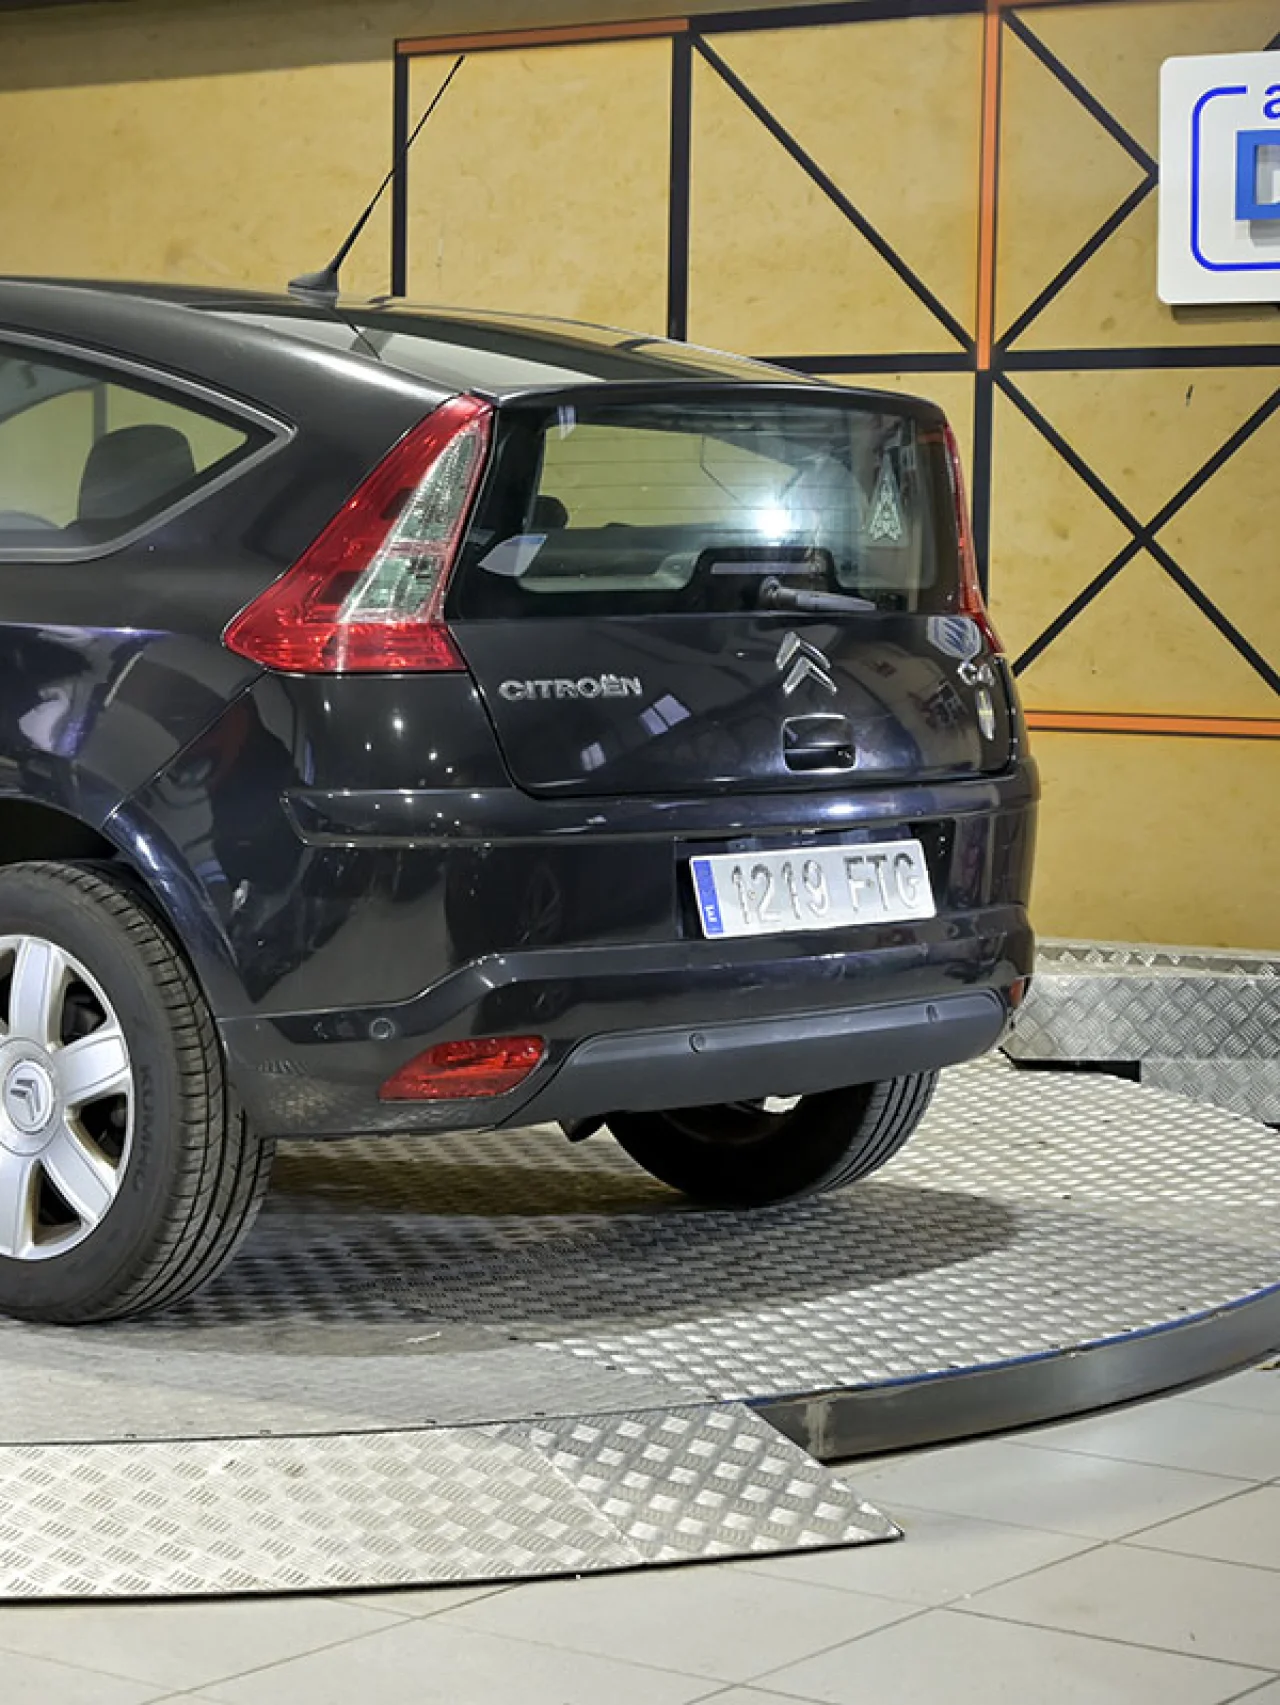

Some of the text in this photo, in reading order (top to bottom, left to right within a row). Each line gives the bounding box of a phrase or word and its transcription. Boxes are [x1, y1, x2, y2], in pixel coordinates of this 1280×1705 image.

[498, 673, 642, 702] CITROËN
[731, 852, 917, 925] 1219 FTG
[704, 905, 719, 923] E
